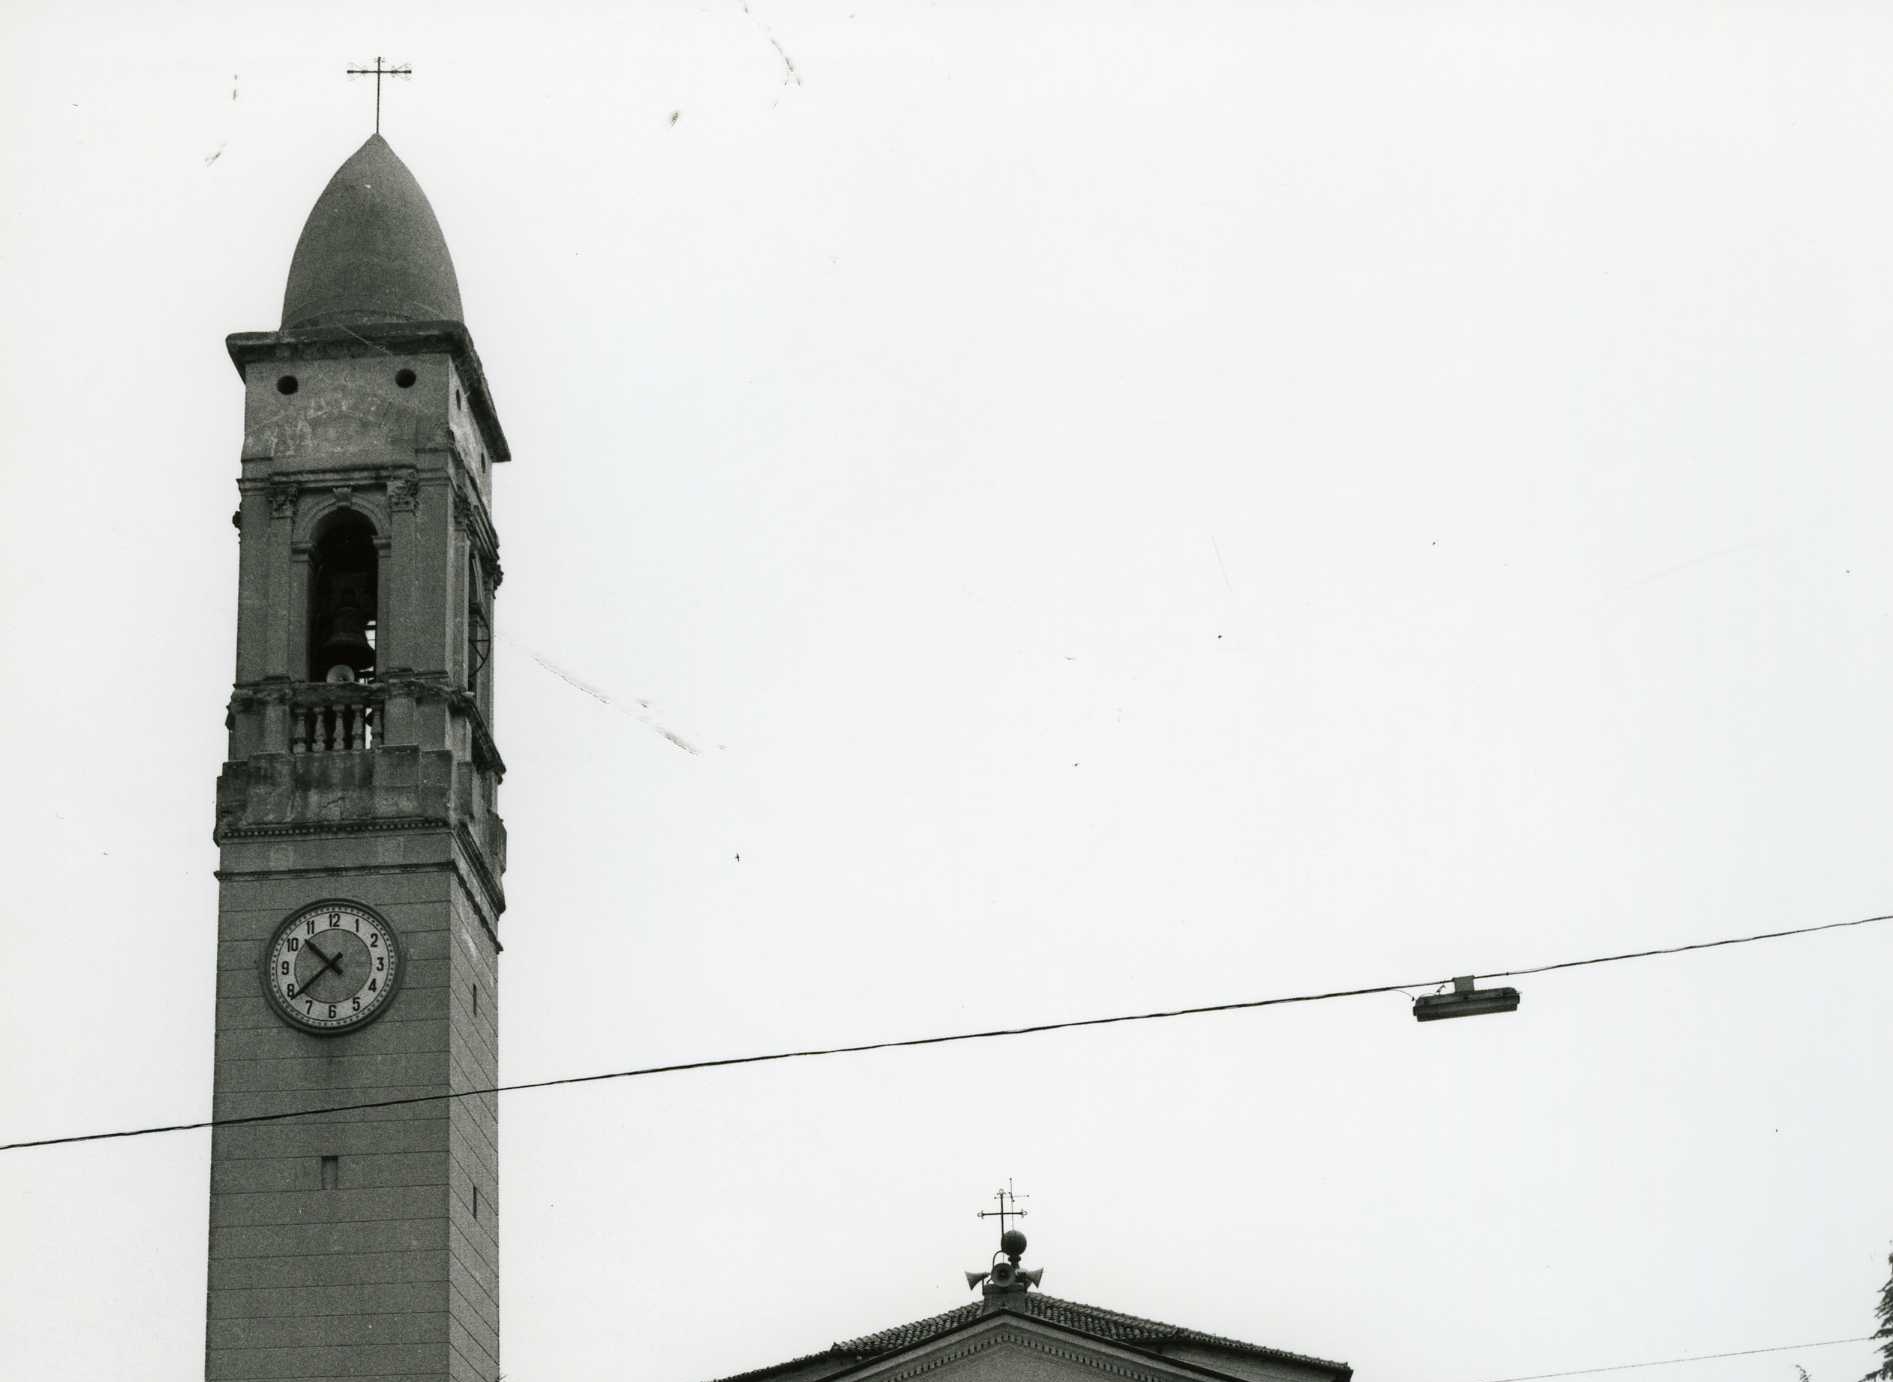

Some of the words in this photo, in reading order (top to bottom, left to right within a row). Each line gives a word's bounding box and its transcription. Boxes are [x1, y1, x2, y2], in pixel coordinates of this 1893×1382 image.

[306, 920, 315, 935] 11
[329, 913, 340, 928] 12
[355, 919, 359, 933] 1
[287, 938, 299, 952] 10
[370, 933, 379, 948] 2
[281, 961, 289, 975] 9
[376, 957, 384, 971] 3
[287, 983, 295, 998] 8
[368, 978, 377, 992] 4
[305, 1000, 313, 1015] 7
[352, 997, 360, 1011] 5
[328, 1005, 336, 1018] 6
